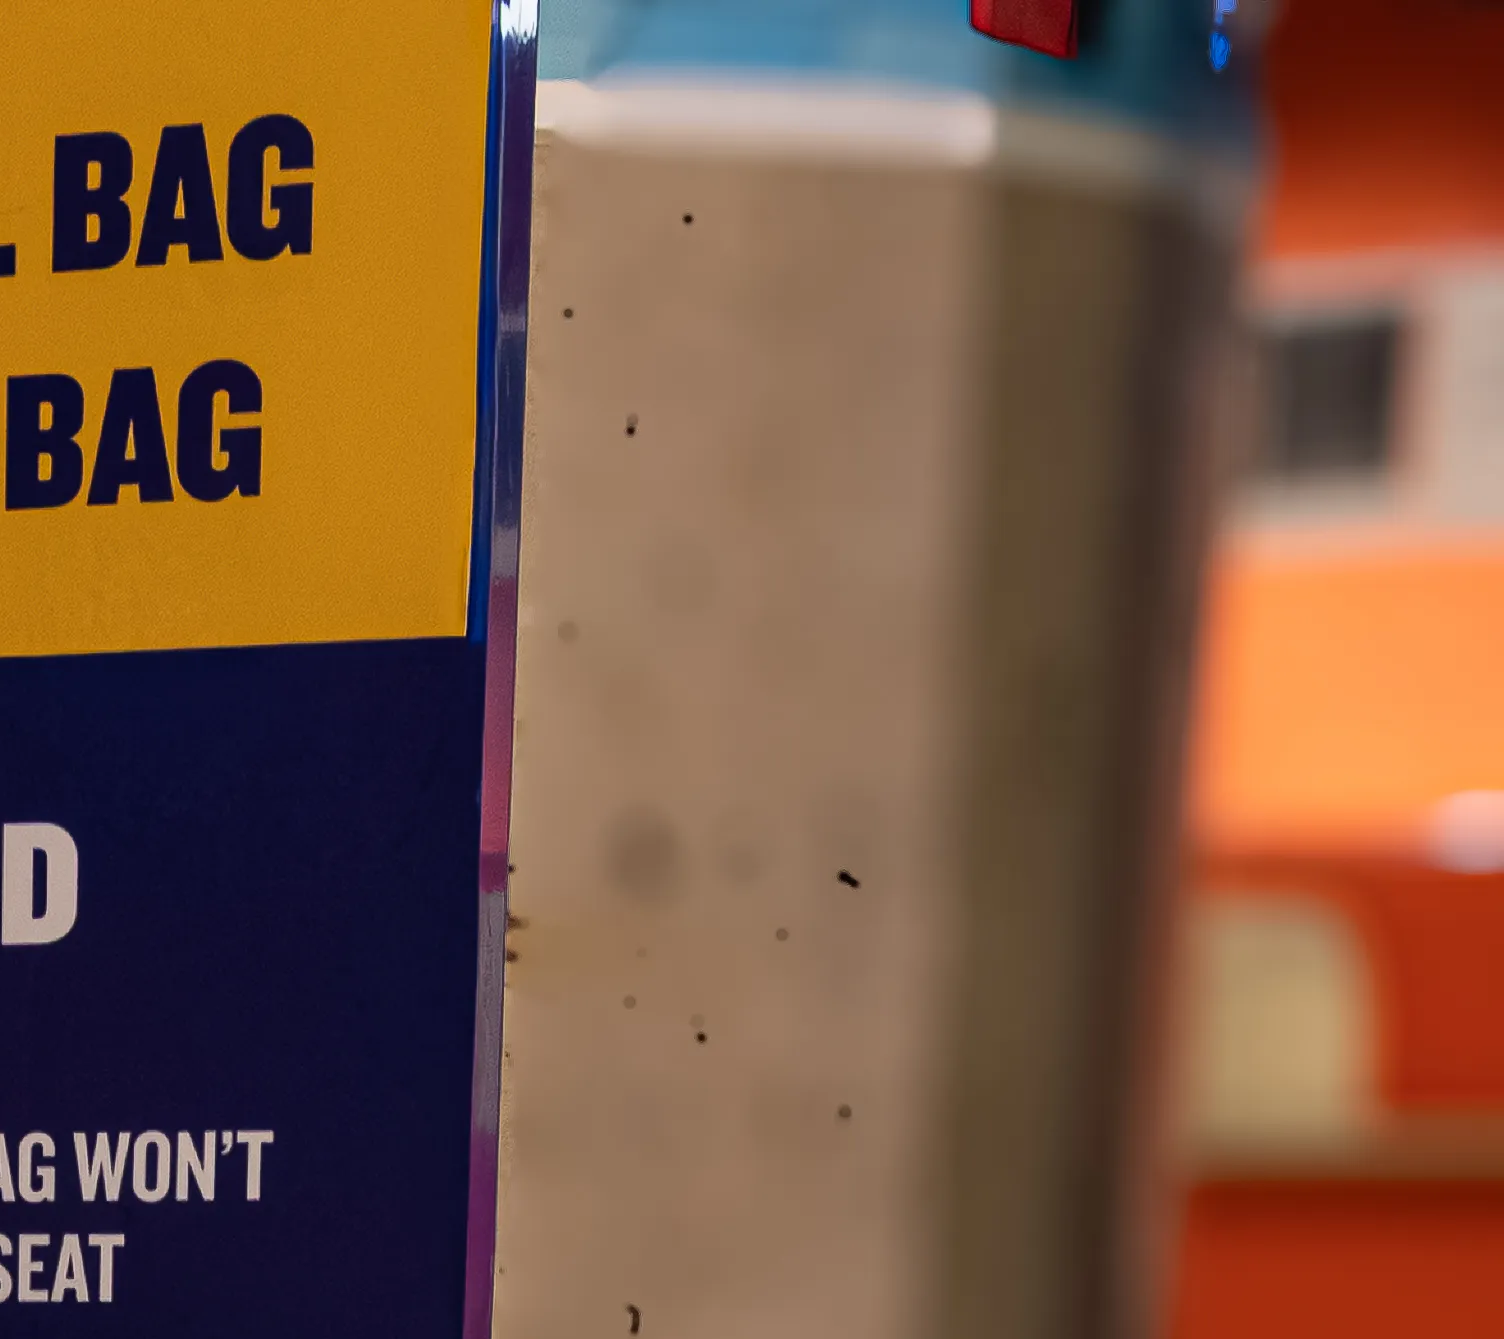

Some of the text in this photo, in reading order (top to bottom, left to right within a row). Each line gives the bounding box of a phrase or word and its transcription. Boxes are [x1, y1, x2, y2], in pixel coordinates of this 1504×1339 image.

[51, 113, 314, 273] BAG
[5, 359, 263, 511] BAG
[73, 1130, 274, 1202] WON’T
